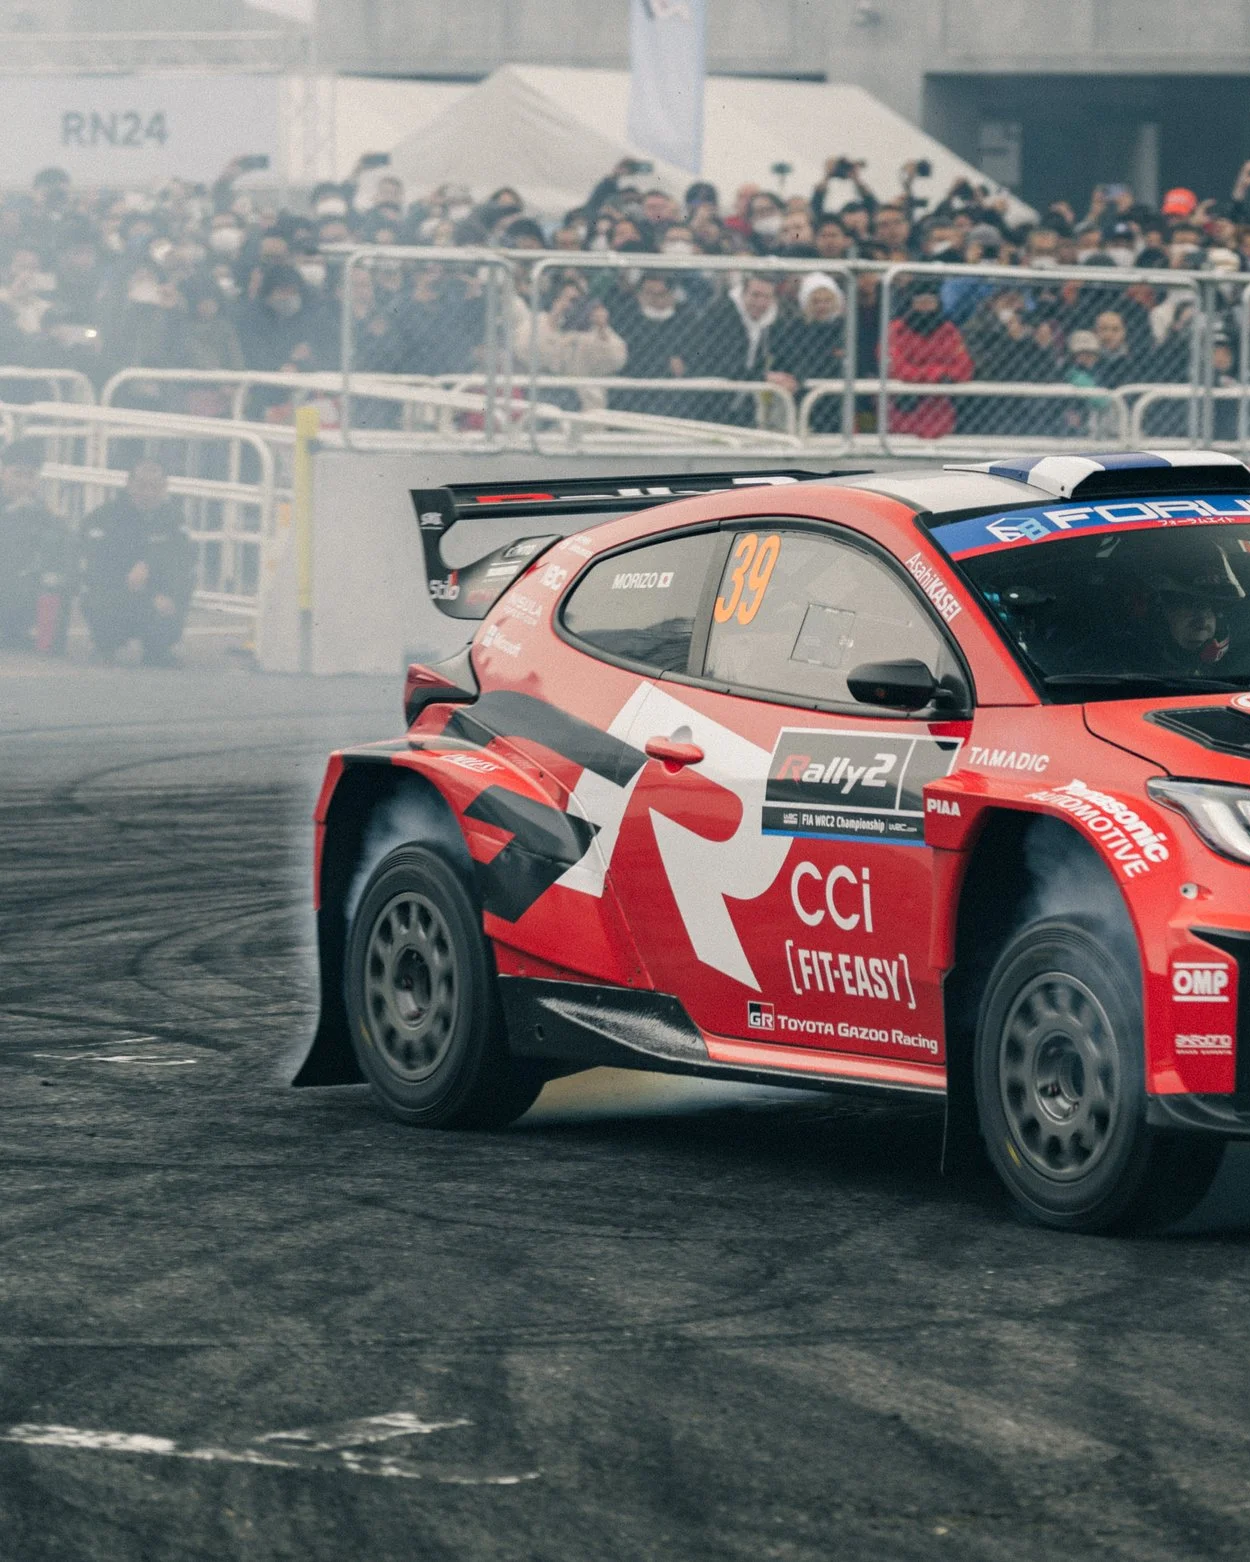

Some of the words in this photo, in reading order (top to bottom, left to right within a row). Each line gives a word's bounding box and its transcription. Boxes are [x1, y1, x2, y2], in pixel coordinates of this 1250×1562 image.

[61, 110, 168, 147] RN24
[1158, 517, 1235, 527] フォーラムエイト
[611, 574, 658, 590] MORIZO
[714, 533, 781, 625] 39
[905, 552, 962, 622] AsahiKASEI
[967, 746, 1050, 773] TAMADIC
[776, 753, 898, 795] Rally2
[926, 798, 962, 817] PIAA
[801, 814, 814, 826] FIA
[815, 815, 834, 828] WRC2
[836, 816, 886, 834] Championship
[1024, 790, 1151, 879] AUTOMOTIVE
[1173, 969, 1229, 994] OMP
[749, 1011, 774, 1028] GR
[777, 1014, 835, 1034] TOYOTA
[837, 1022, 889, 1042] GAZOO
[891, 1028, 938, 1053] Racing
